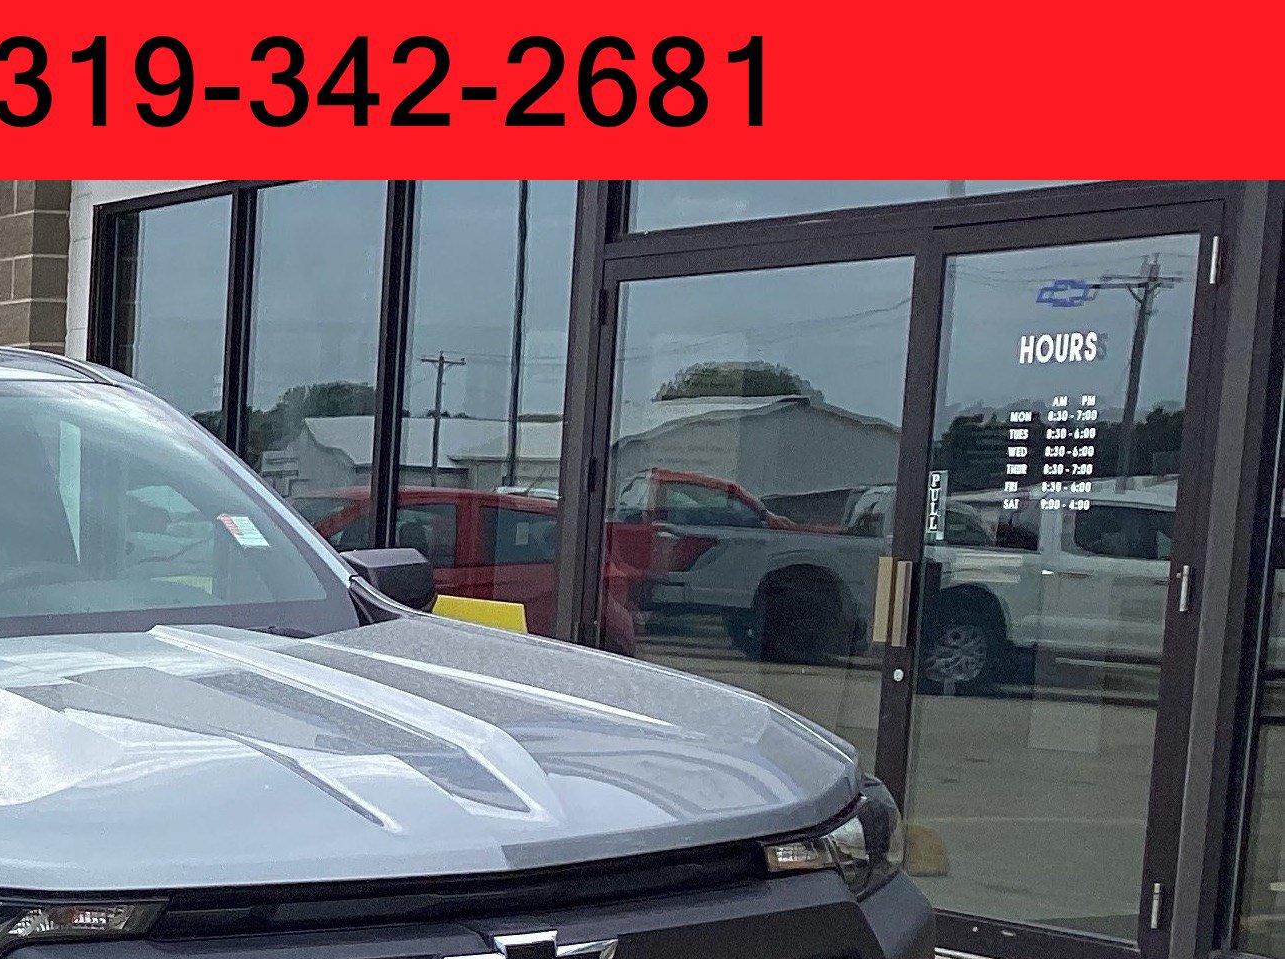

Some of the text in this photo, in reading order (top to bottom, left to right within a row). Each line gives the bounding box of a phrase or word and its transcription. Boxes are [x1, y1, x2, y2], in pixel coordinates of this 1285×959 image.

[1019, 331, 1098, 364] HOURS
[1052, 395, 1096, 407] AM PM
[1010, 411, 1032, 422] MON
[1076, 409, 1098, 421] 7:00
[1009, 429, 1029, 440] TUES
[1008, 446, 1028, 457] WED
[928, 473, 941, 531] PULL
[1003, 498, 1020, 510] SAT
